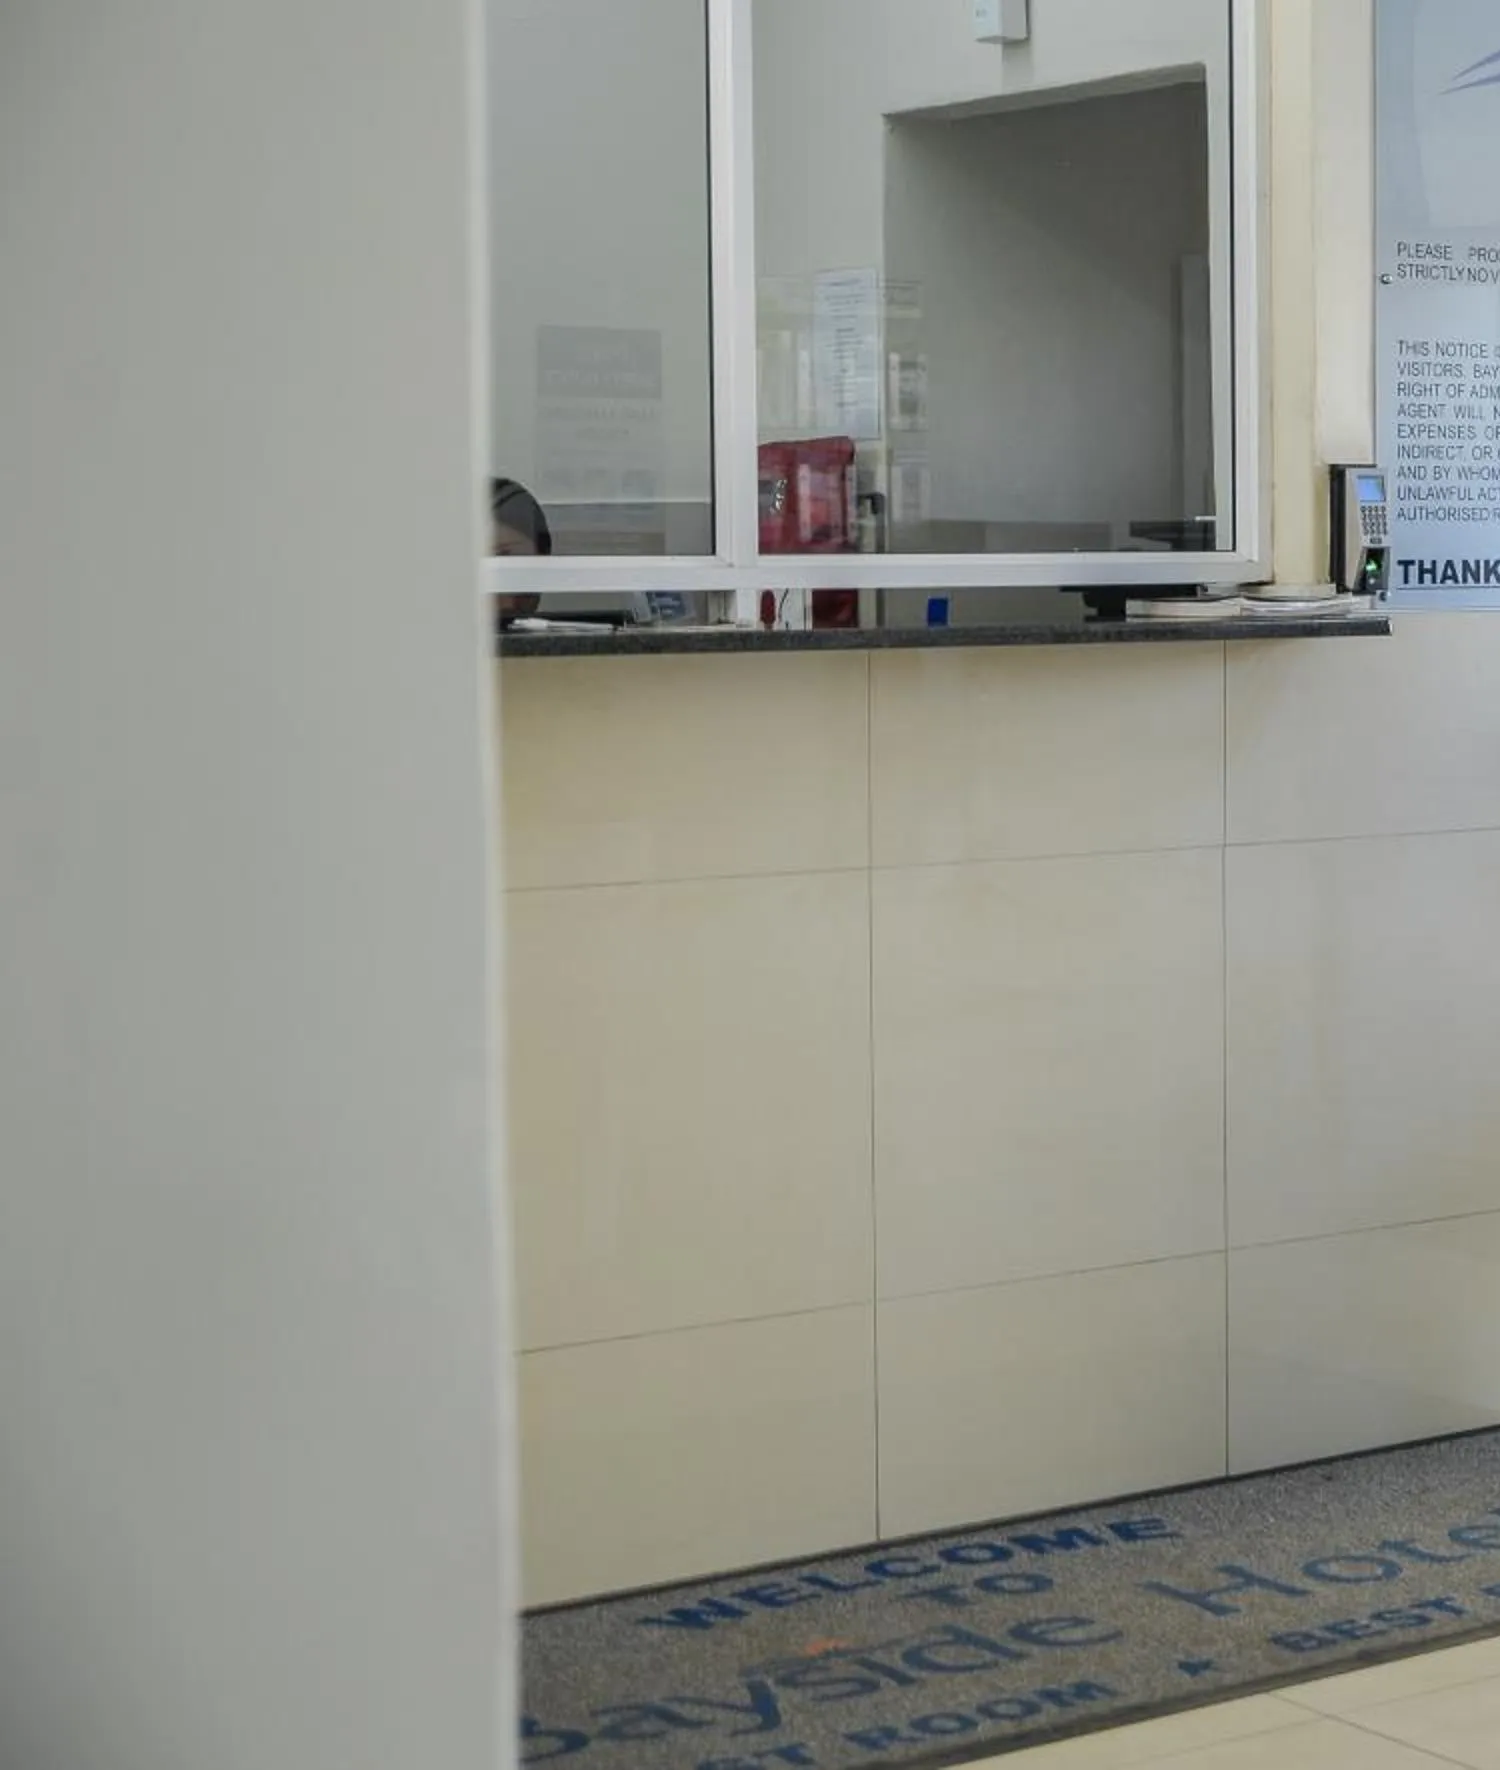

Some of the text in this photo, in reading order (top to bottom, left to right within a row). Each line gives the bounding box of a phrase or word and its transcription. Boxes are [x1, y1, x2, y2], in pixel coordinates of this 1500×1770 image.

[1397, 241, 1453, 260] PLEASE
[1397, 262, 1464, 282] STRICTLY
[1466, 267, 1487, 282] NO
[1397, 340, 1430, 358] THIS
[1434, 342, 1489, 359] NOTICE
[1397, 381, 1441, 400] RIGHT
[1445, 383, 1465, 399] OF
[1397, 402, 1446, 419] AGENT
[1453, 404, 1485, 420] WILL
[1397, 423, 1478, 442] EXPENSES
[1471, 445, 1493, 461] OR
[1397, 466, 1428, 482] AND
[1432, 466, 1453, 482] BY
[1397, 485, 1475, 502] UNLAWFUL
[1397, 506, 1489, 523] AUTHORISED
[636, 1516, 1182, 1631] WELCOME
[887, 1571, 1056, 1607] TO
[843, 1678, 1120, 1751] ROOM
[1268, 1596, 1474, 1654] BEST
